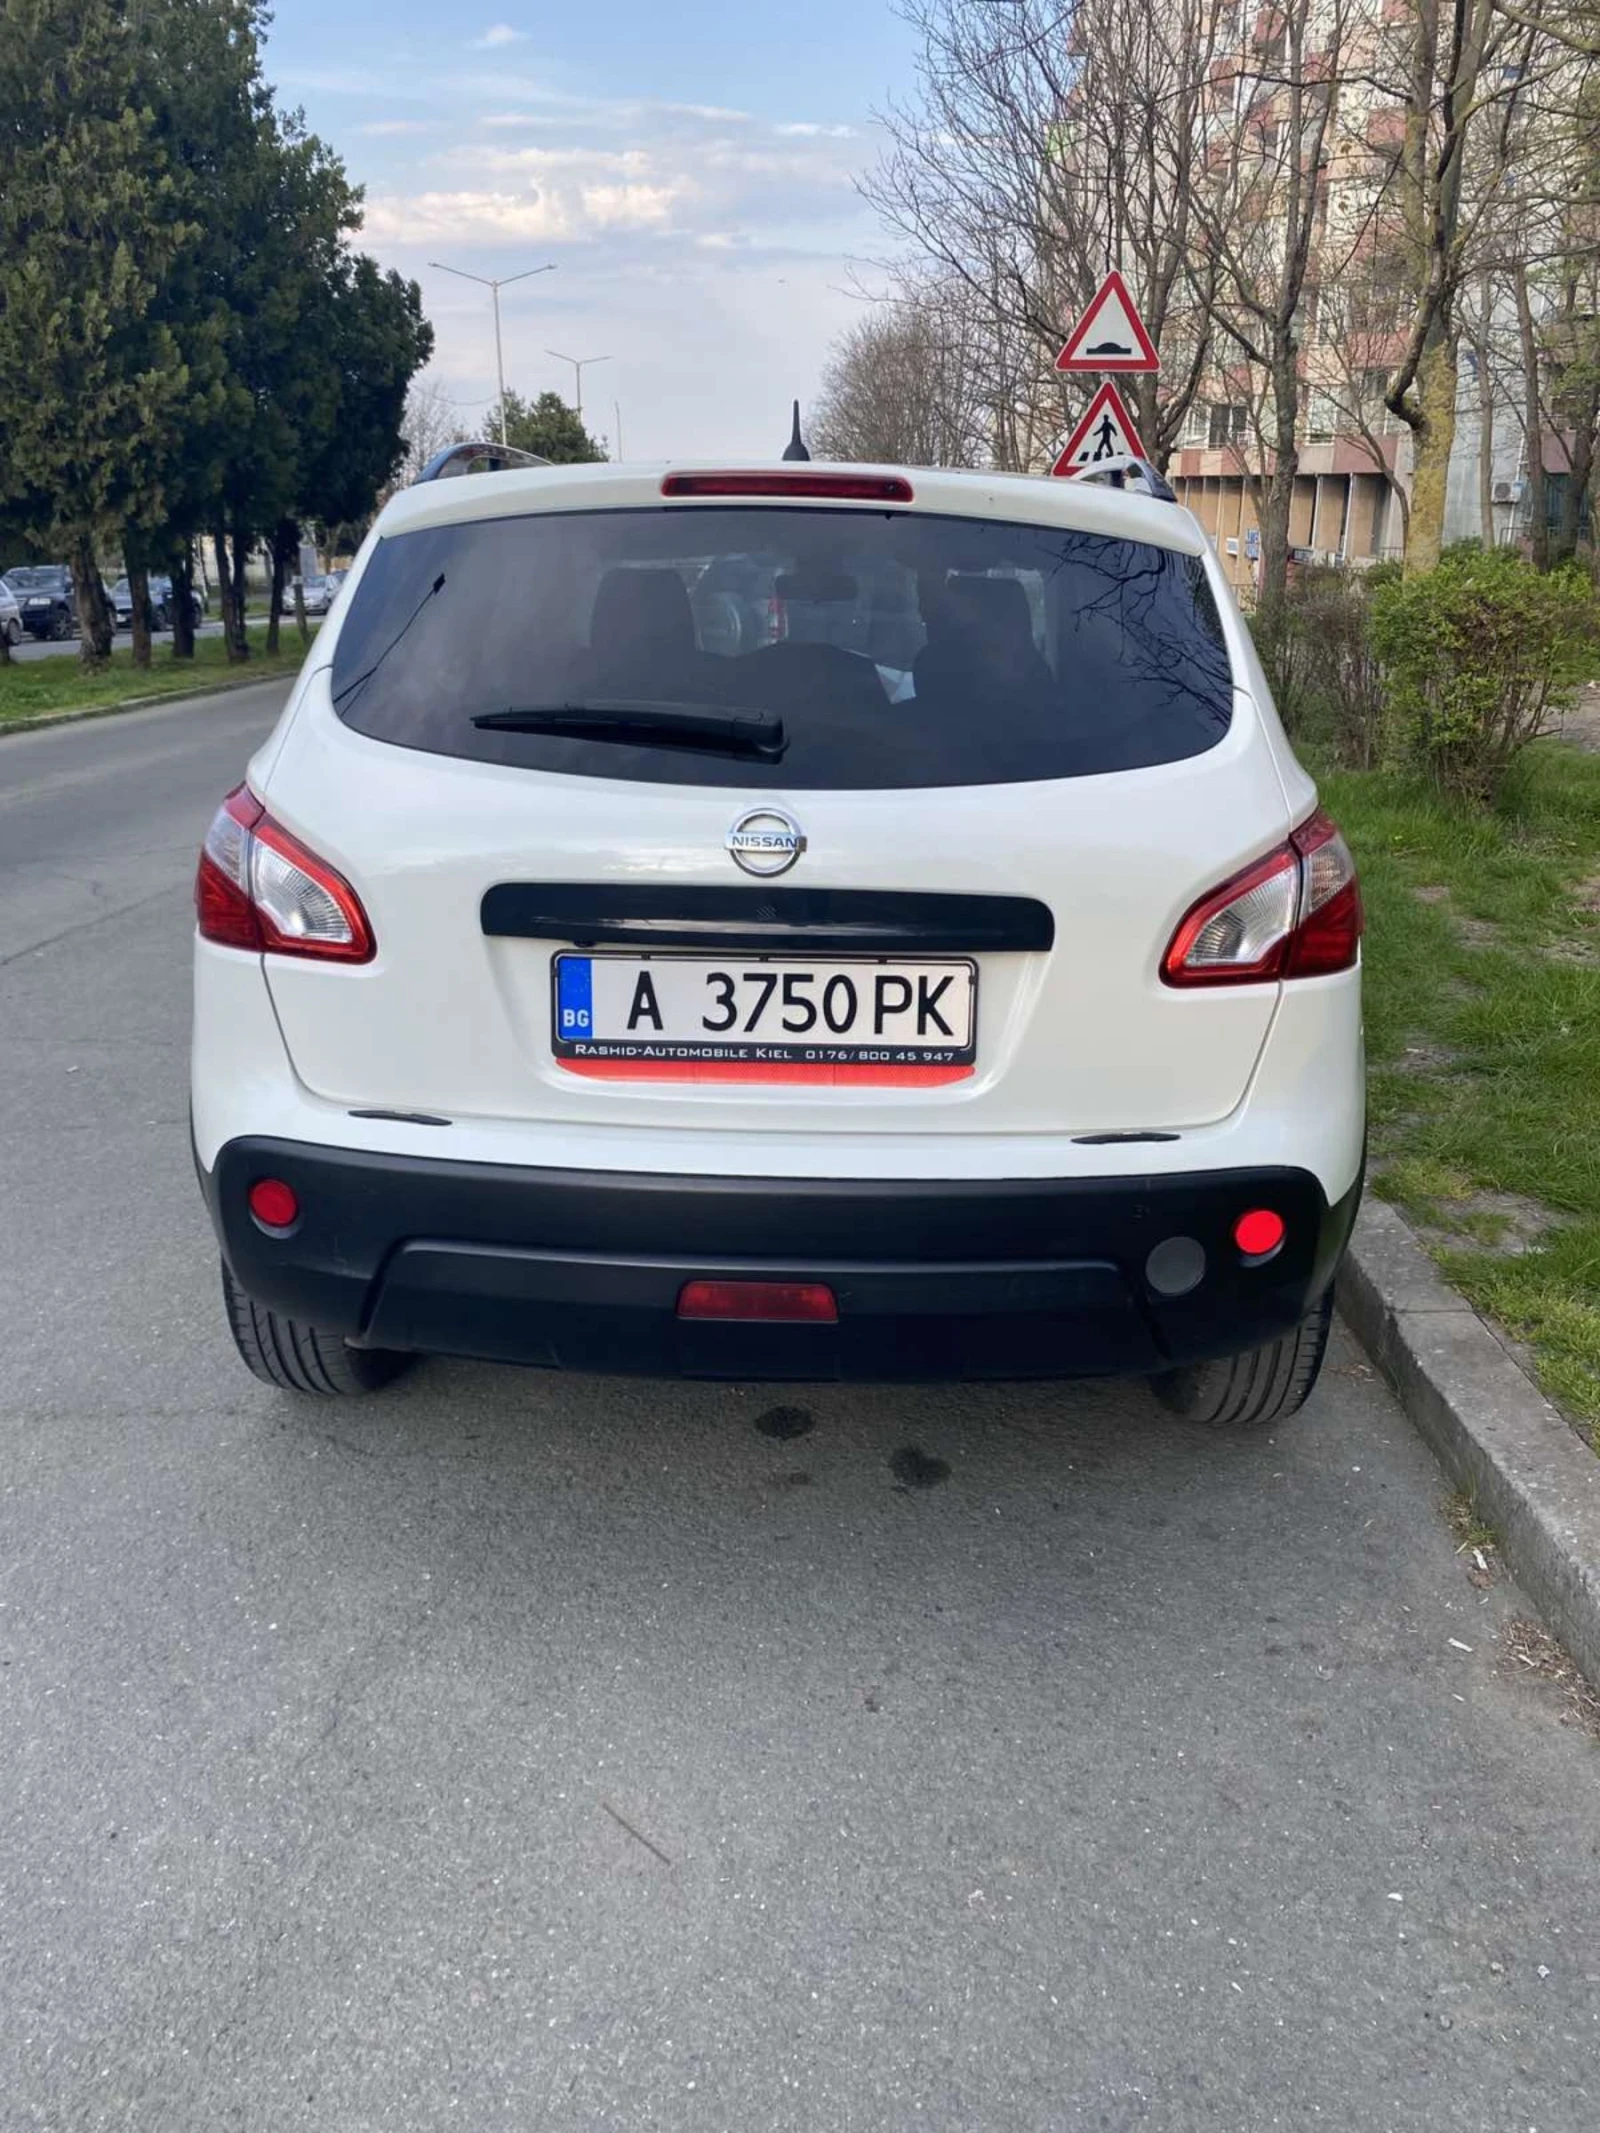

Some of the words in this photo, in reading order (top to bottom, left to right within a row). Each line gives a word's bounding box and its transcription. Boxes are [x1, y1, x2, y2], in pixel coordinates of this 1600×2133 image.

[732, 835, 798, 848] NISSAN
[626, 970, 664, 1031] A
[702, 972, 858, 1034] 3750
[873, 975, 954, 1036] PK
[563, 1008, 590, 1027] BG
[896, 1051, 917, 1061] 45
[923, 1052, 954, 1062] 947
